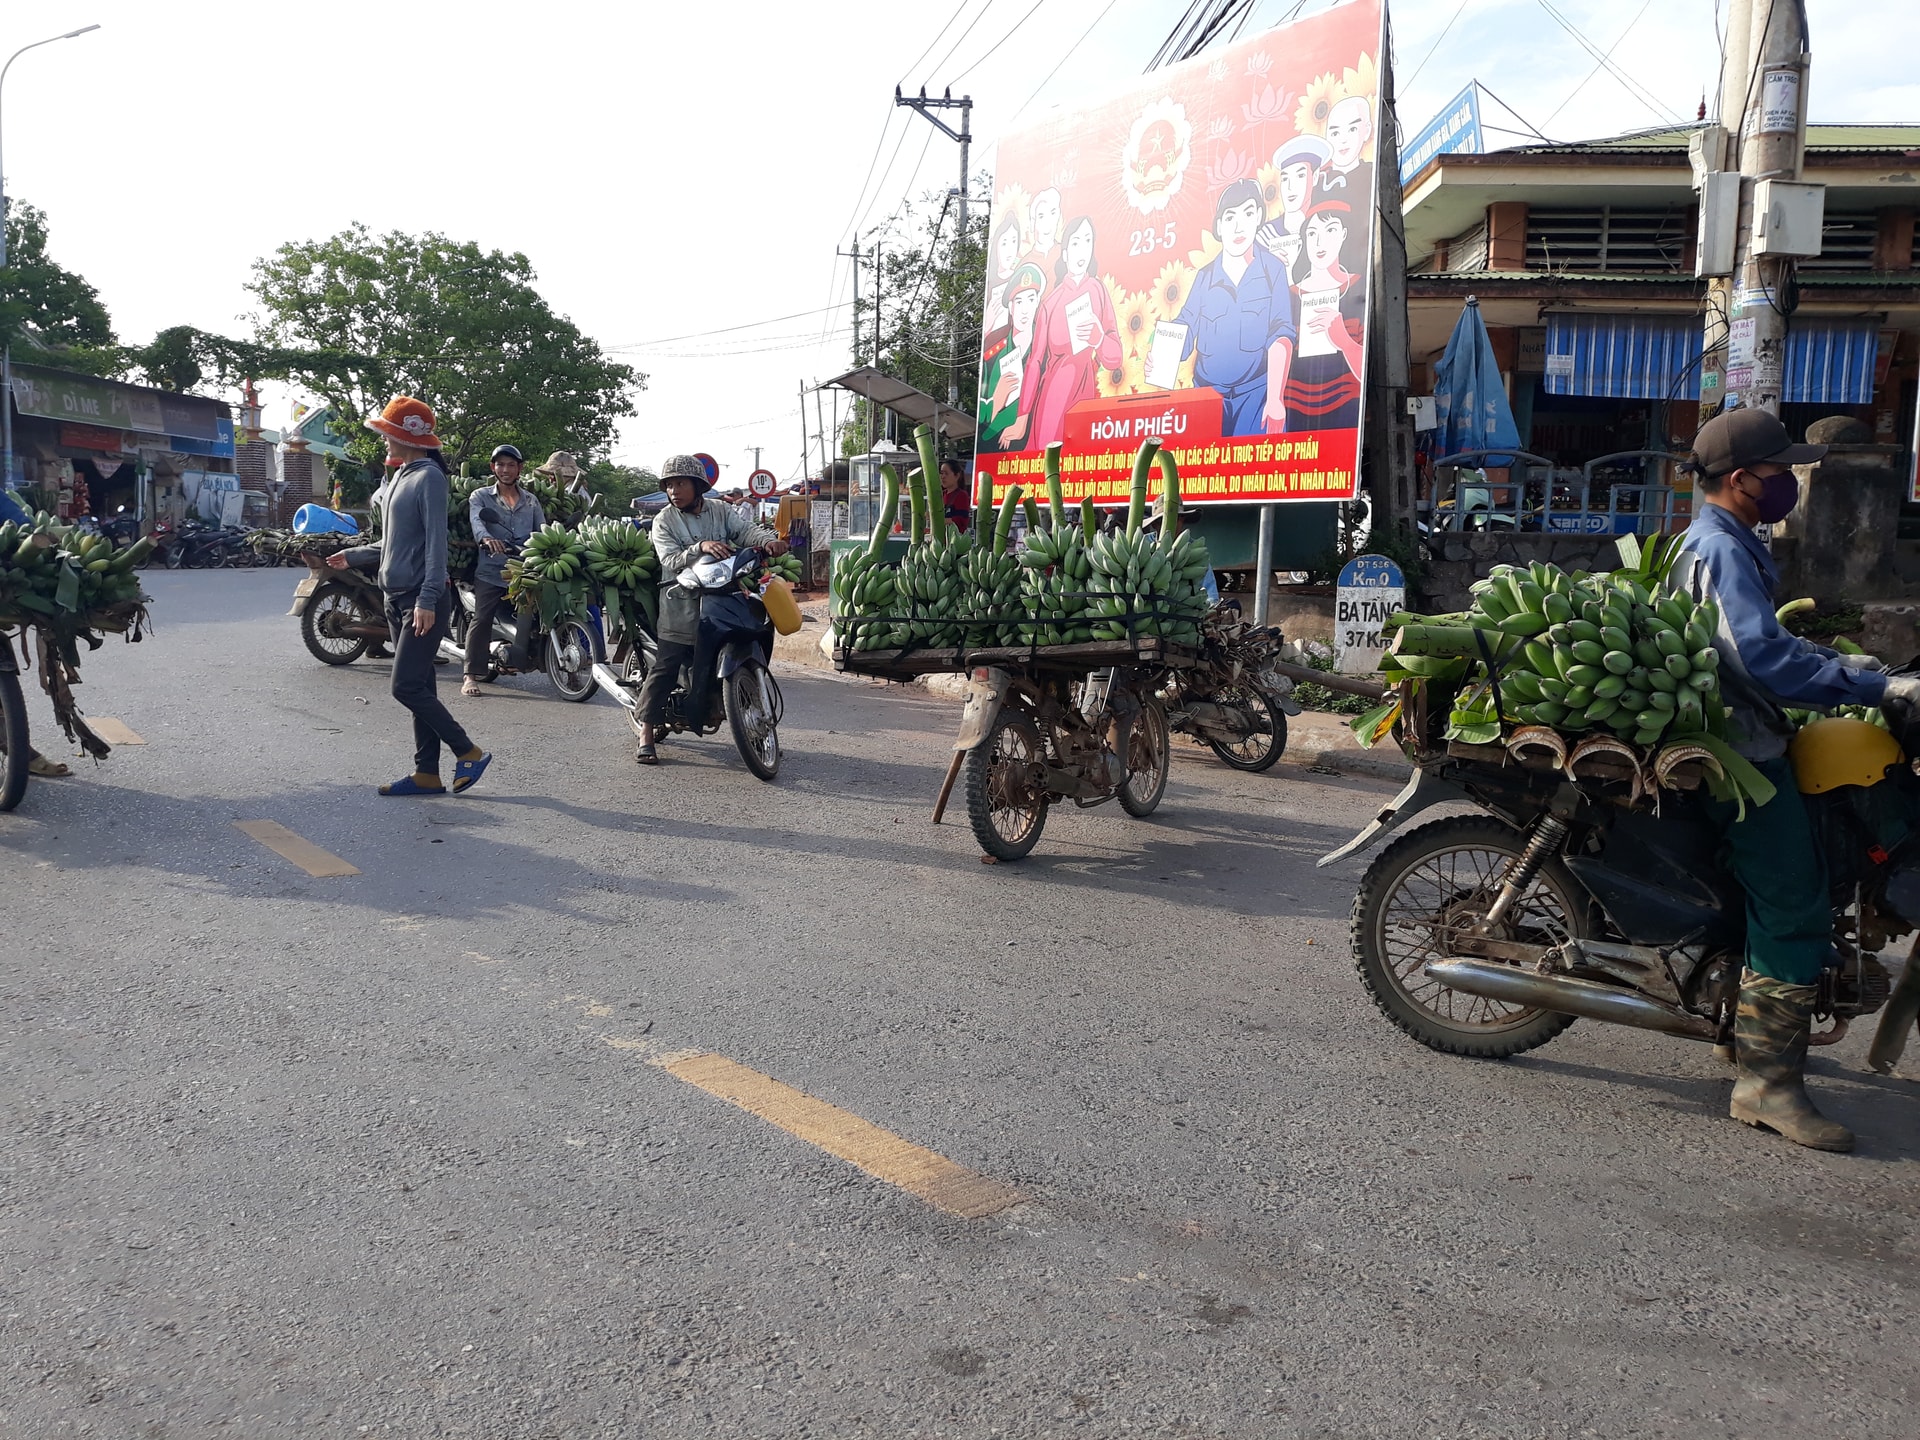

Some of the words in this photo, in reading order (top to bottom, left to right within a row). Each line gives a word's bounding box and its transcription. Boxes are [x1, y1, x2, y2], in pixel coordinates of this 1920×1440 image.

[1128, 221, 1177, 257] 23-5
[1091, 416, 1130, 440] HÒM
[1134, 408, 1187, 437] PHIẾU
[1019, 459, 1030, 477] ĐẠI
[1063, 453, 1074, 475] HỘI
[1075, 453, 1084, 471] VÀ
[1085, 454, 1097, 474] ĐẠI
[1097, 448, 1113, 471] BIỂU
[1114, 450, 1126, 472] HỘI
[1187, 445, 1203, 466] CÁC
[1203, 441, 1220, 465] CẤP
[1220, 443, 1231, 464] LÀ
[1233, 443, 1254, 467] TRỰC
[1256, 439, 1273, 461] TIẾP
[1275, 439, 1293, 461] GÓP
[1294, 435, 1319, 460] PHẦN
[1074, 480, 1084, 497] XÃ
[1085, 478, 1097, 500] HỘI
[1097, 476, 1111, 497] CHỦ
[1186, 473, 1208, 494] NHÂN
[1209, 472, 1228, 495] DÂN,
[1229, 476, 1241, 493] DO
[1242, 471, 1265, 492] NHÂN
[1267, 470, 1287, 493] DÂN,
[1289, 469, 1299, 491] VÌ
[1300, 468, 1325, 490] NHÂN
[1339, 602, 1360, 622] BA
